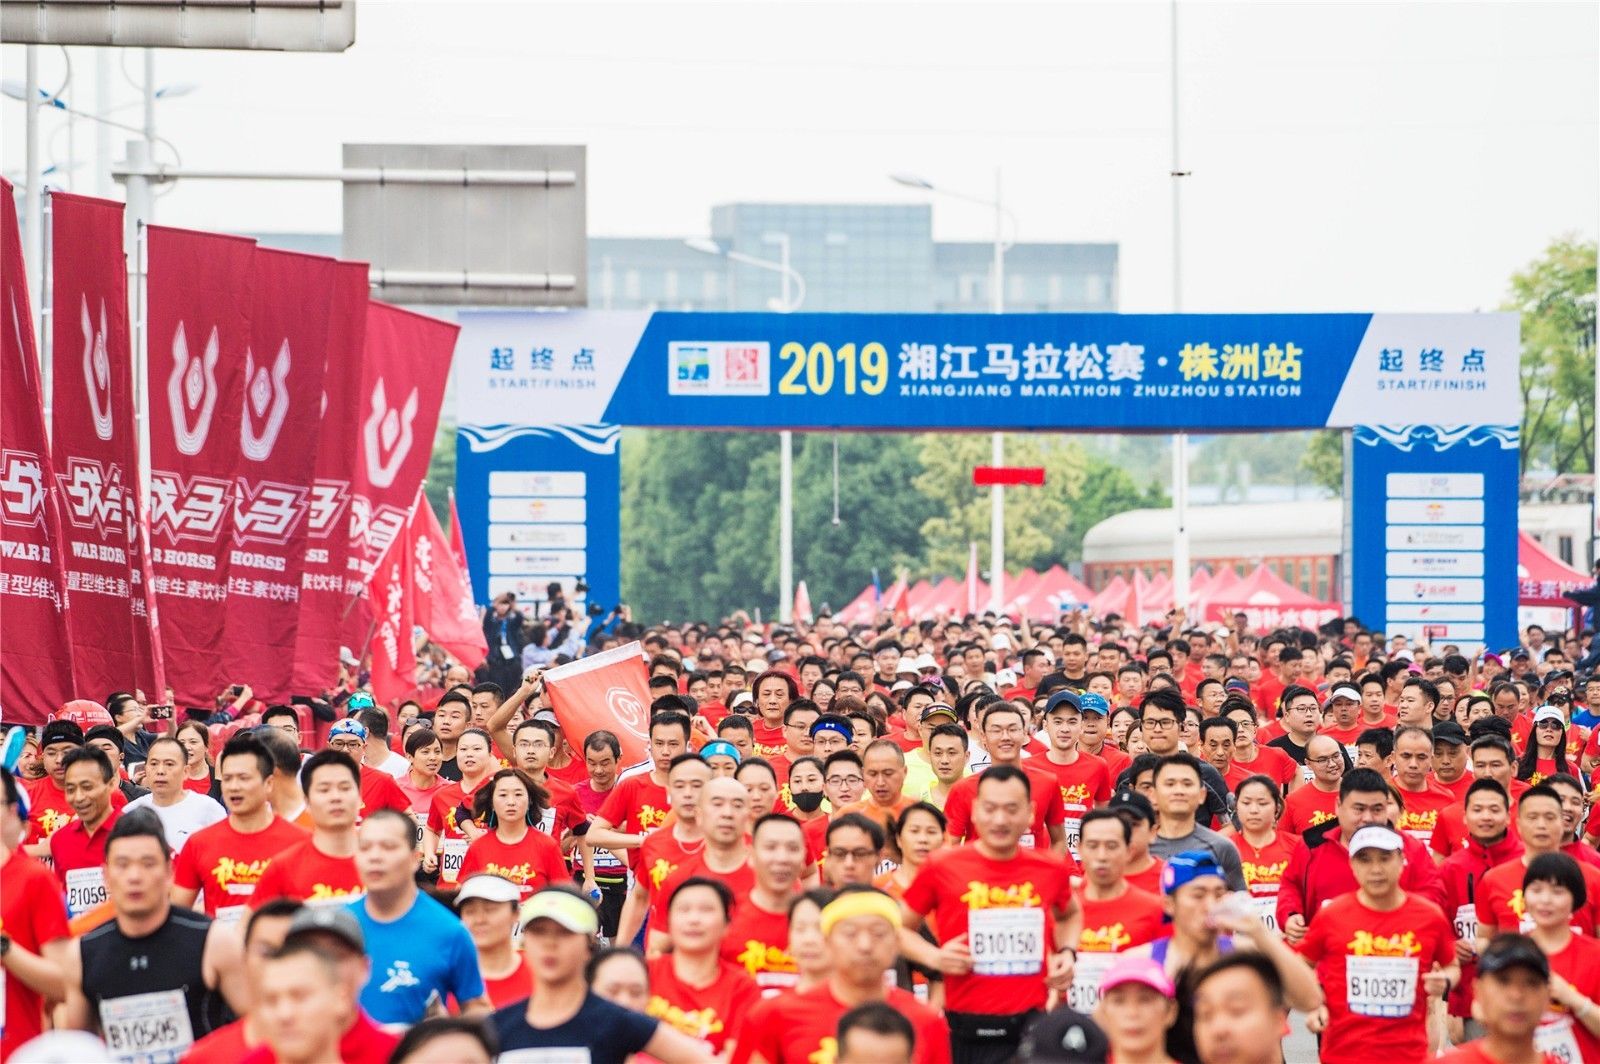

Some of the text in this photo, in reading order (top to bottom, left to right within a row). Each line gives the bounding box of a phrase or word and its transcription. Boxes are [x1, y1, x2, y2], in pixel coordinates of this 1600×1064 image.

[490, 347, 596, 371] 起终点
[778, 342, 889, 396] 2019
[1379, 347, 1486, 372] 起终点
[488, 377, 596, 390] START/FINISH
[900, 384, 1302, 397] XIANGJIANG MARATHON ZHUZHOU STATION
[1377, 379, 1487, 391] START/FINISH
[0, 540, 41, 561] WAR
[71, 541, 98, 560] WAR
[98, 545, 126, 565] HOR
[165, 550, 216, 570] HORSE
[230, 550, 286, 571] HORSE
[69, 885, 108, 907] B1059
[975, 932, 1036, 955] B10150
[1350, 976, 1407, 999] B10387
